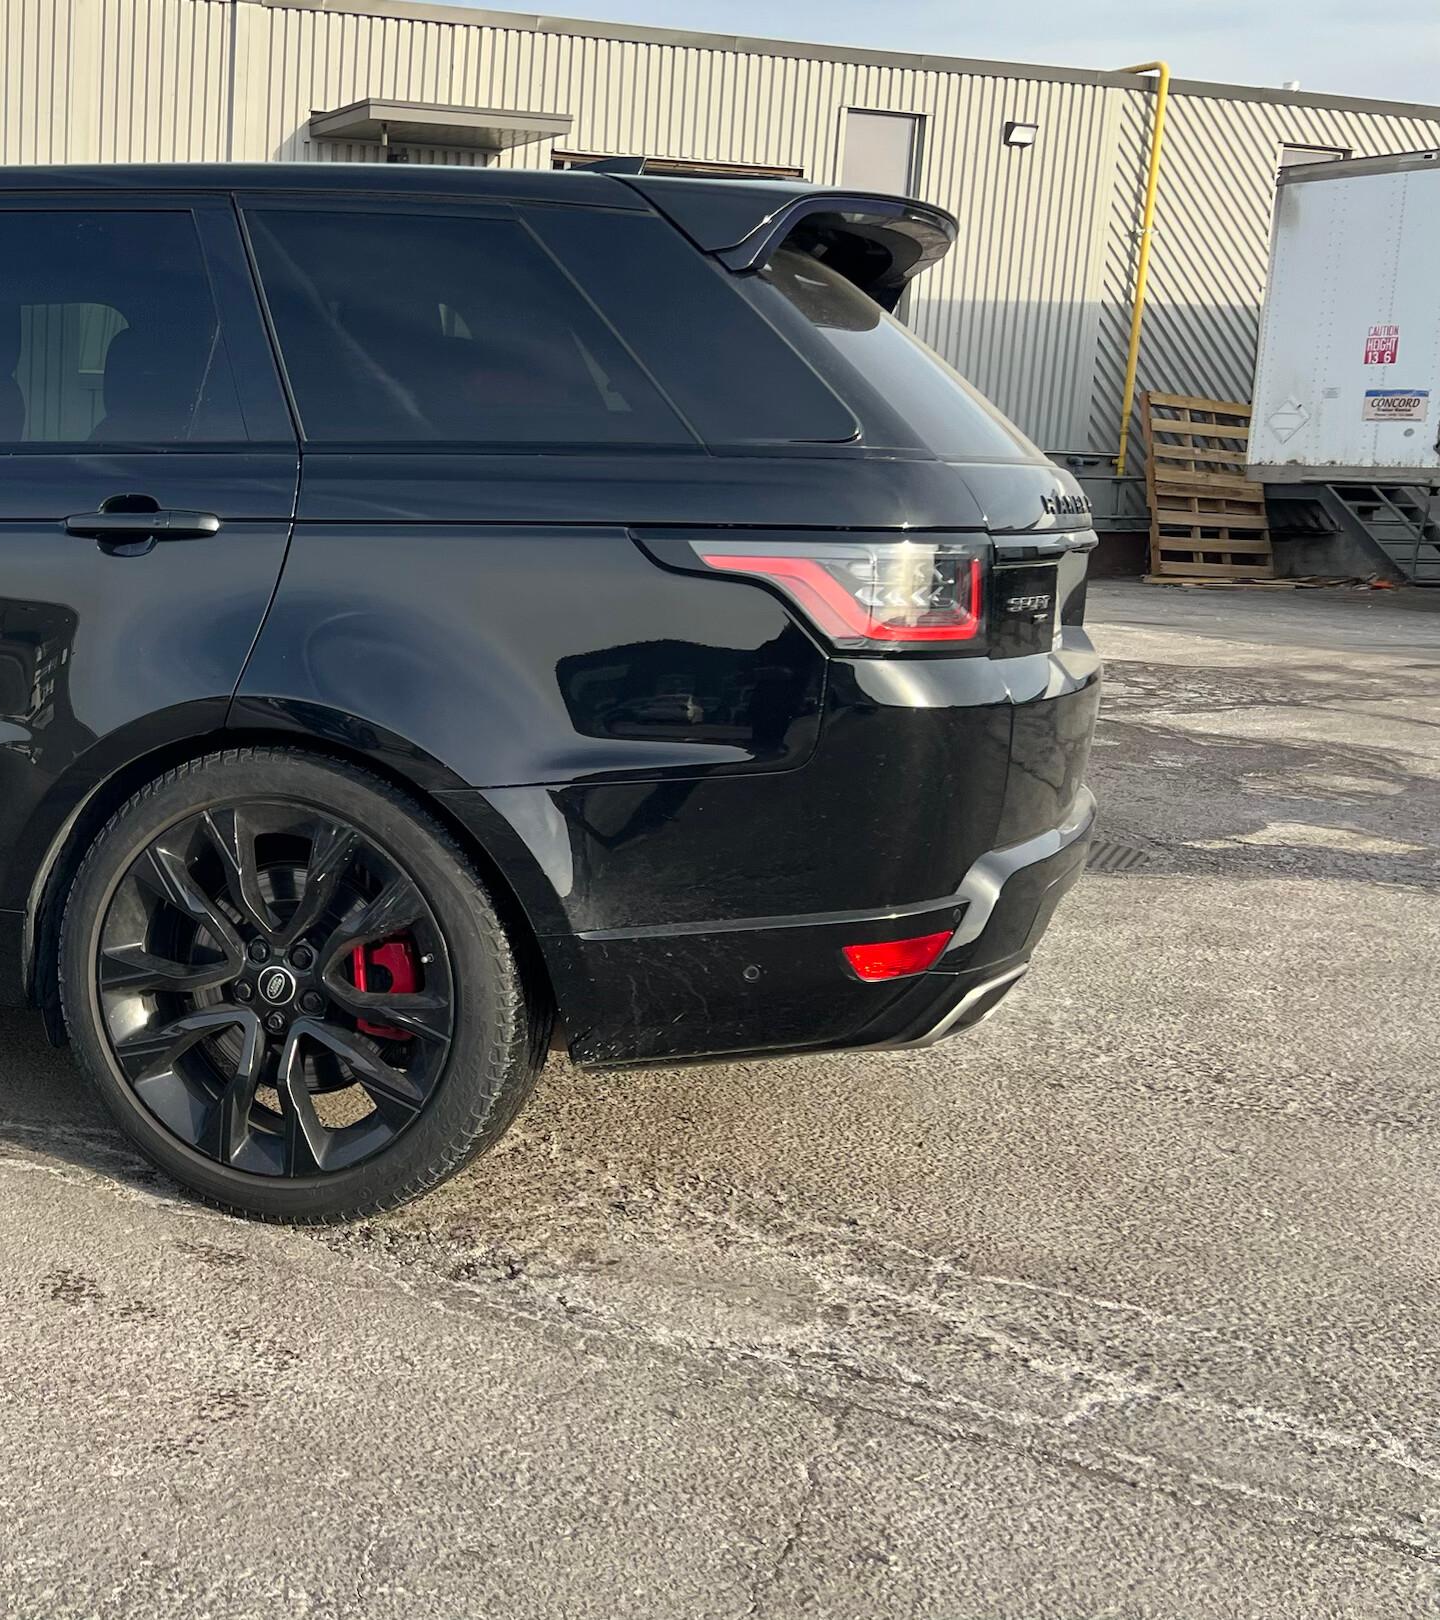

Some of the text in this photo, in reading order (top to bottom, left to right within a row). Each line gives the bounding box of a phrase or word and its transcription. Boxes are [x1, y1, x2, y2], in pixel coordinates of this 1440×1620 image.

[1368, 326, 1399, 336] CAUTION
[1366, 338, 1396, 351] HEIGHT
[1367, 351, 1391, 363] 13 6
[1371, 398, 1421, 408] CONCORD
